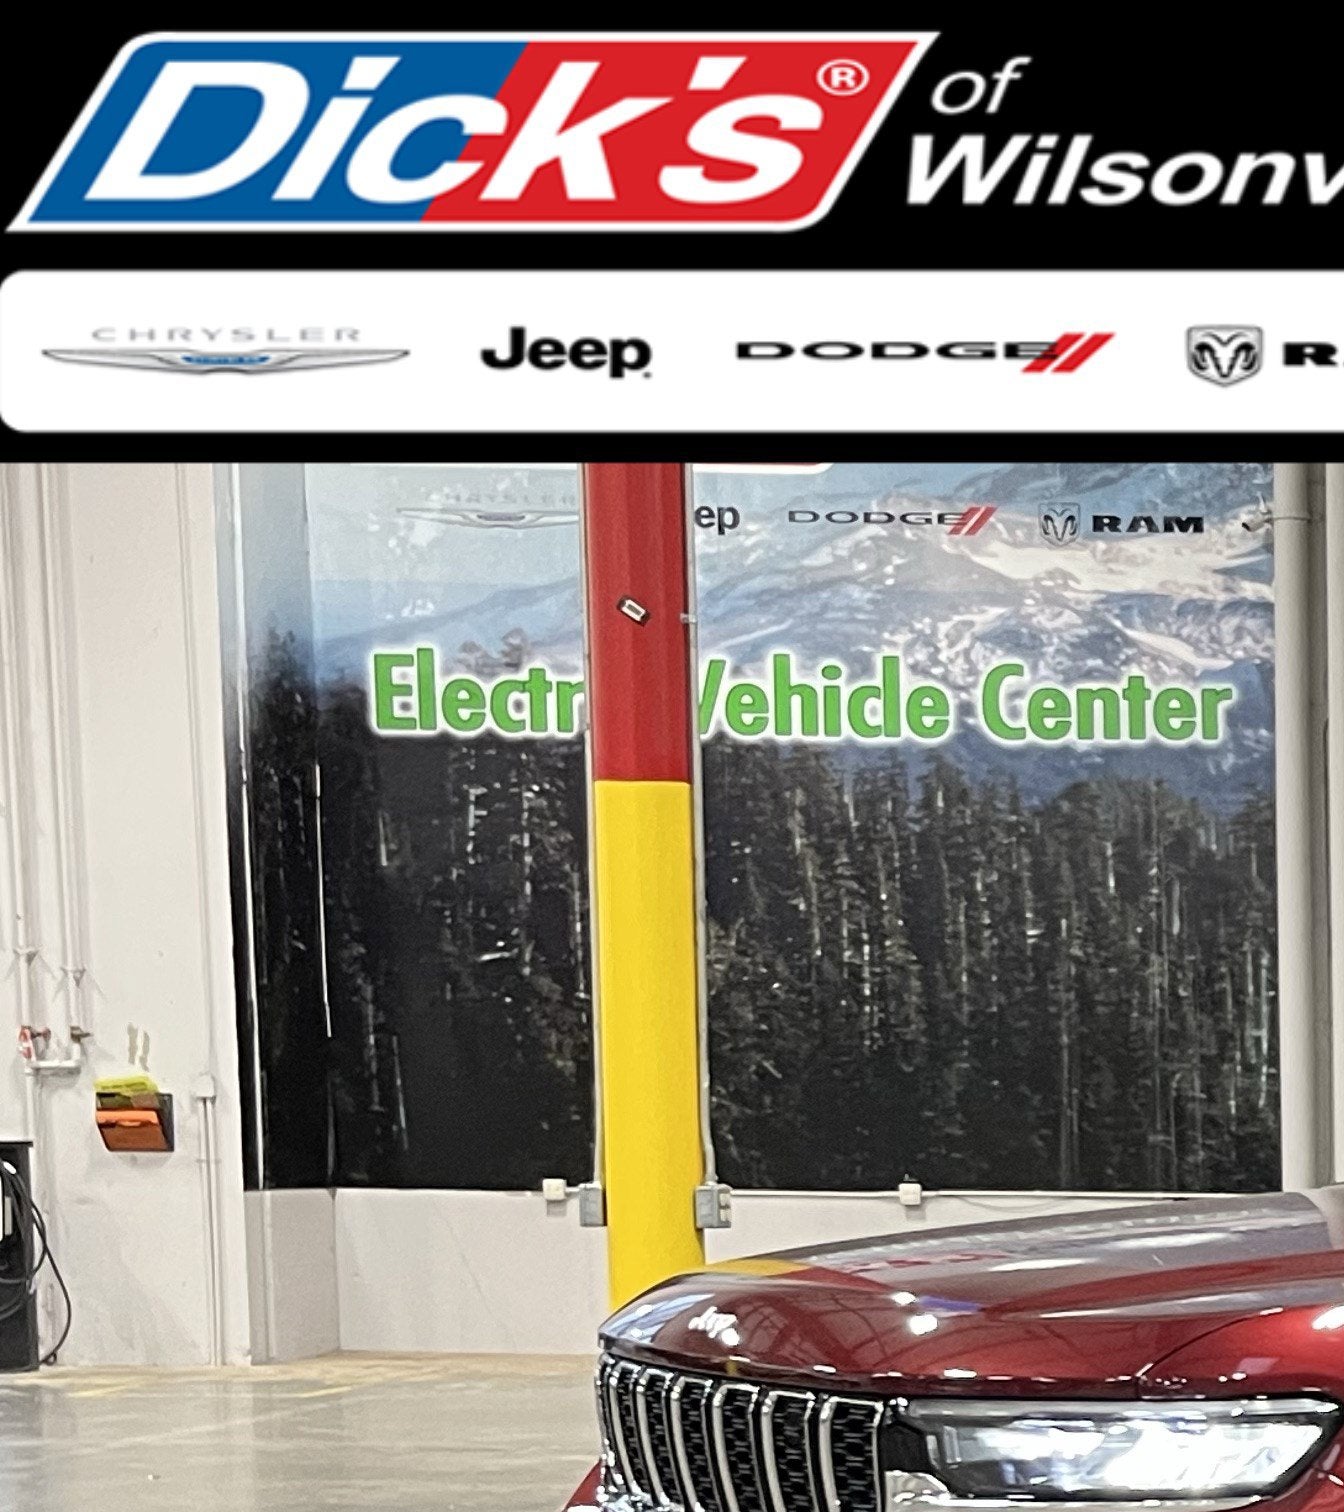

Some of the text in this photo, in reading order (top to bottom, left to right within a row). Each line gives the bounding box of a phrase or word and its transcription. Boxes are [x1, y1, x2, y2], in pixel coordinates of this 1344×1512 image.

[695, 506, 740, 535] ep
[787, 510, 964, 526] DODGE
[1092, 515, 1204, 534] RAM
[373, 647, 584, 733] Electr
[981, 662, 1233, 741] Center
